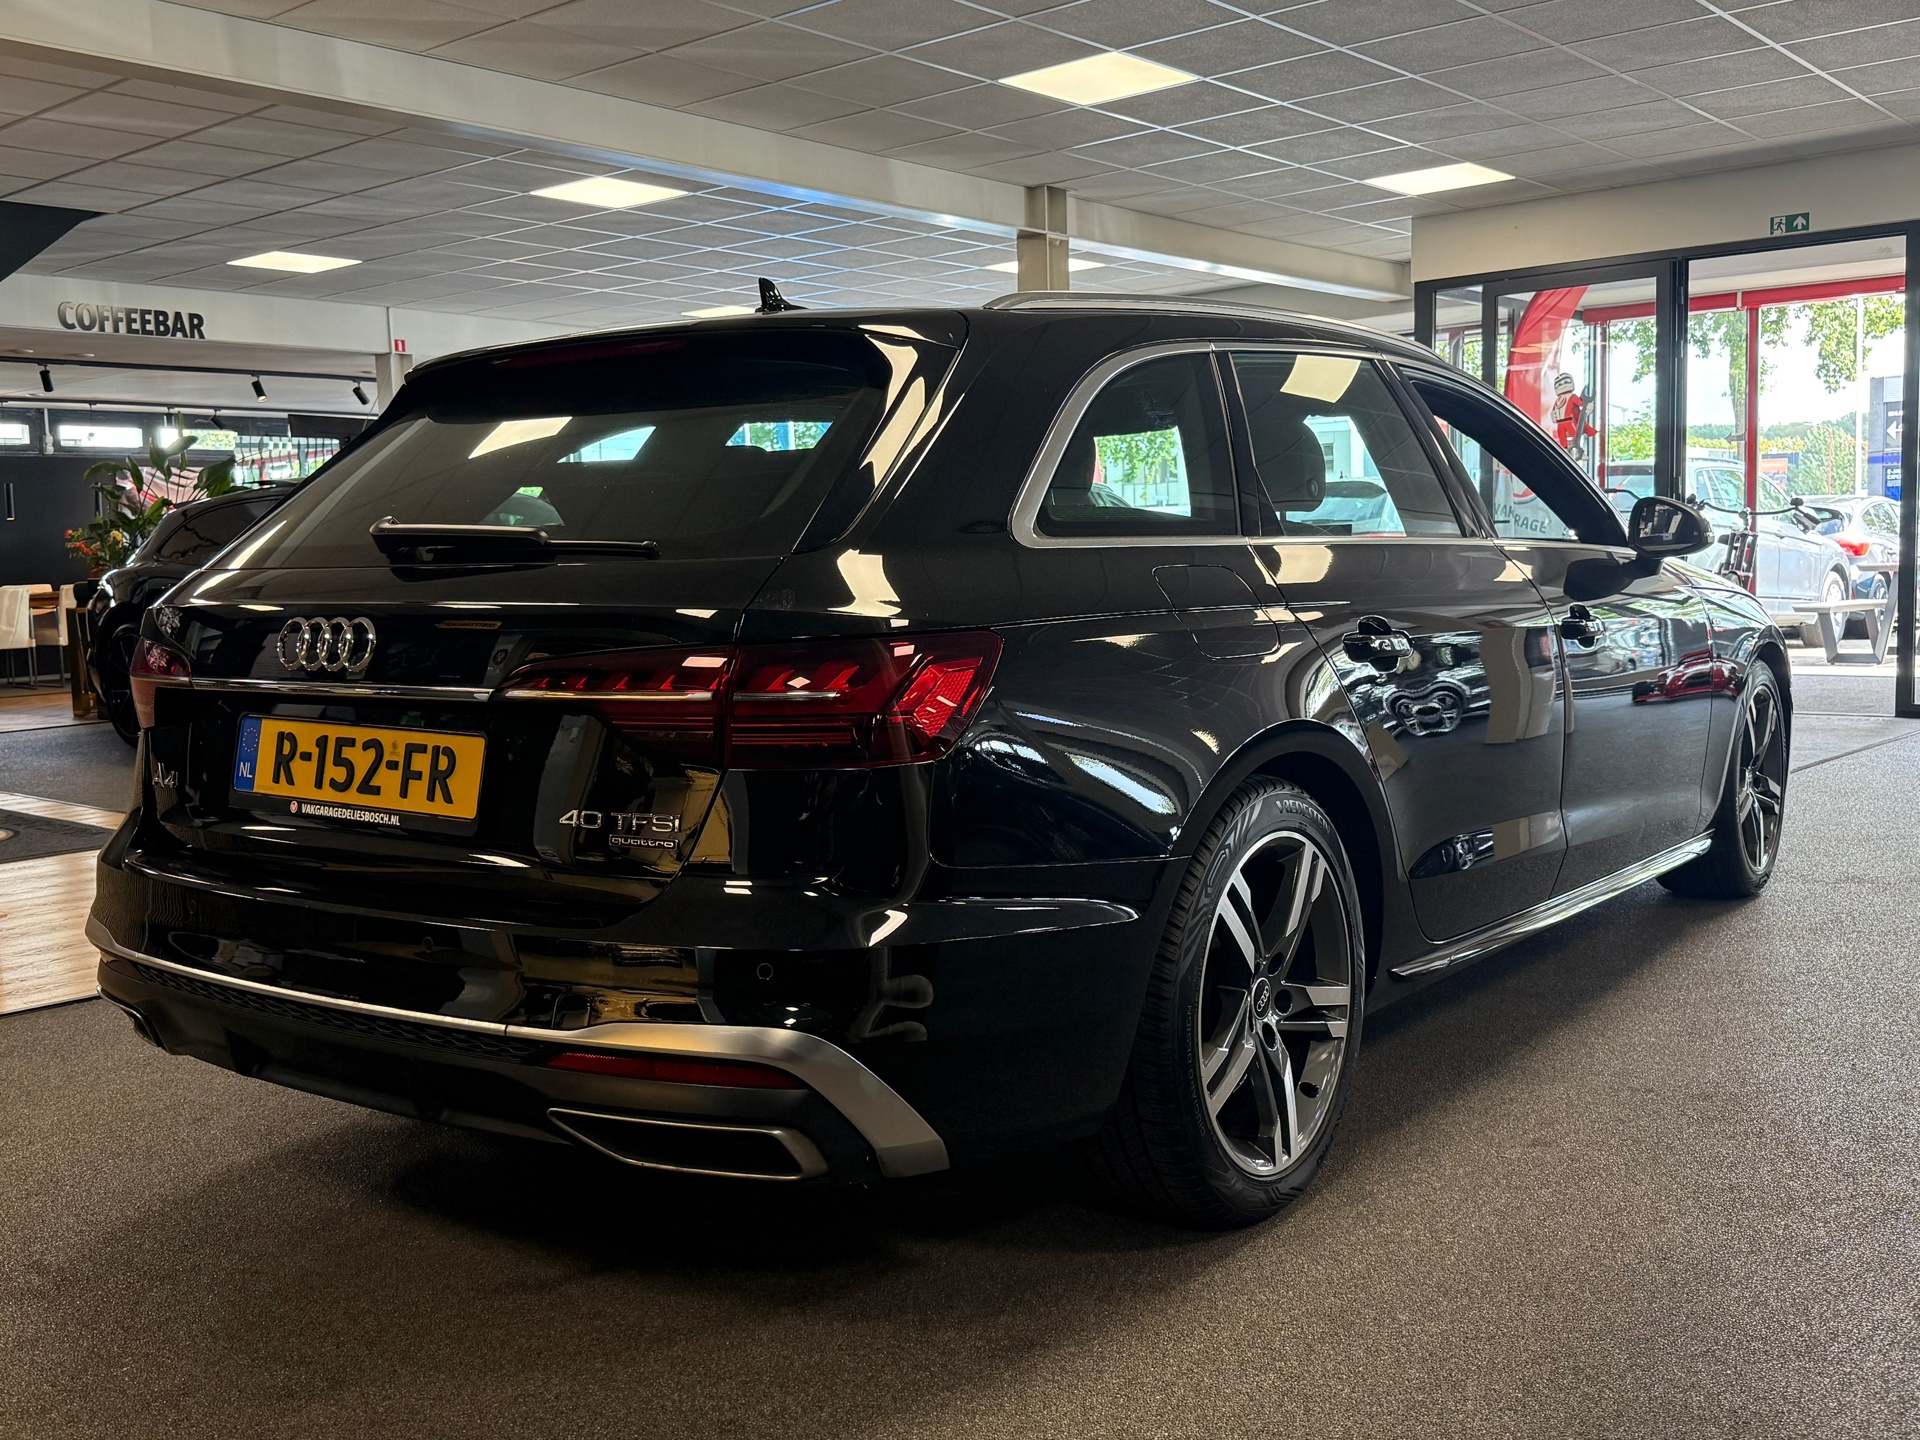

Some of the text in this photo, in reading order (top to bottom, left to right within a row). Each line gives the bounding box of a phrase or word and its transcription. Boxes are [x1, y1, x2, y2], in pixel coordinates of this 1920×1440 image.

[57, 301, 206, 340] COFFEEBAR
[152, 762, 178, 788] A4
[238, 761, 253, 778] NL
[271, 731, 457, 805] R-152-FR
[301, 803, 400, 826] VAKGARAGEDELIESBOSCH.NL
[559, 809, 680, 833] 40 TFSI
[611, 837, 674, 848] quattro
